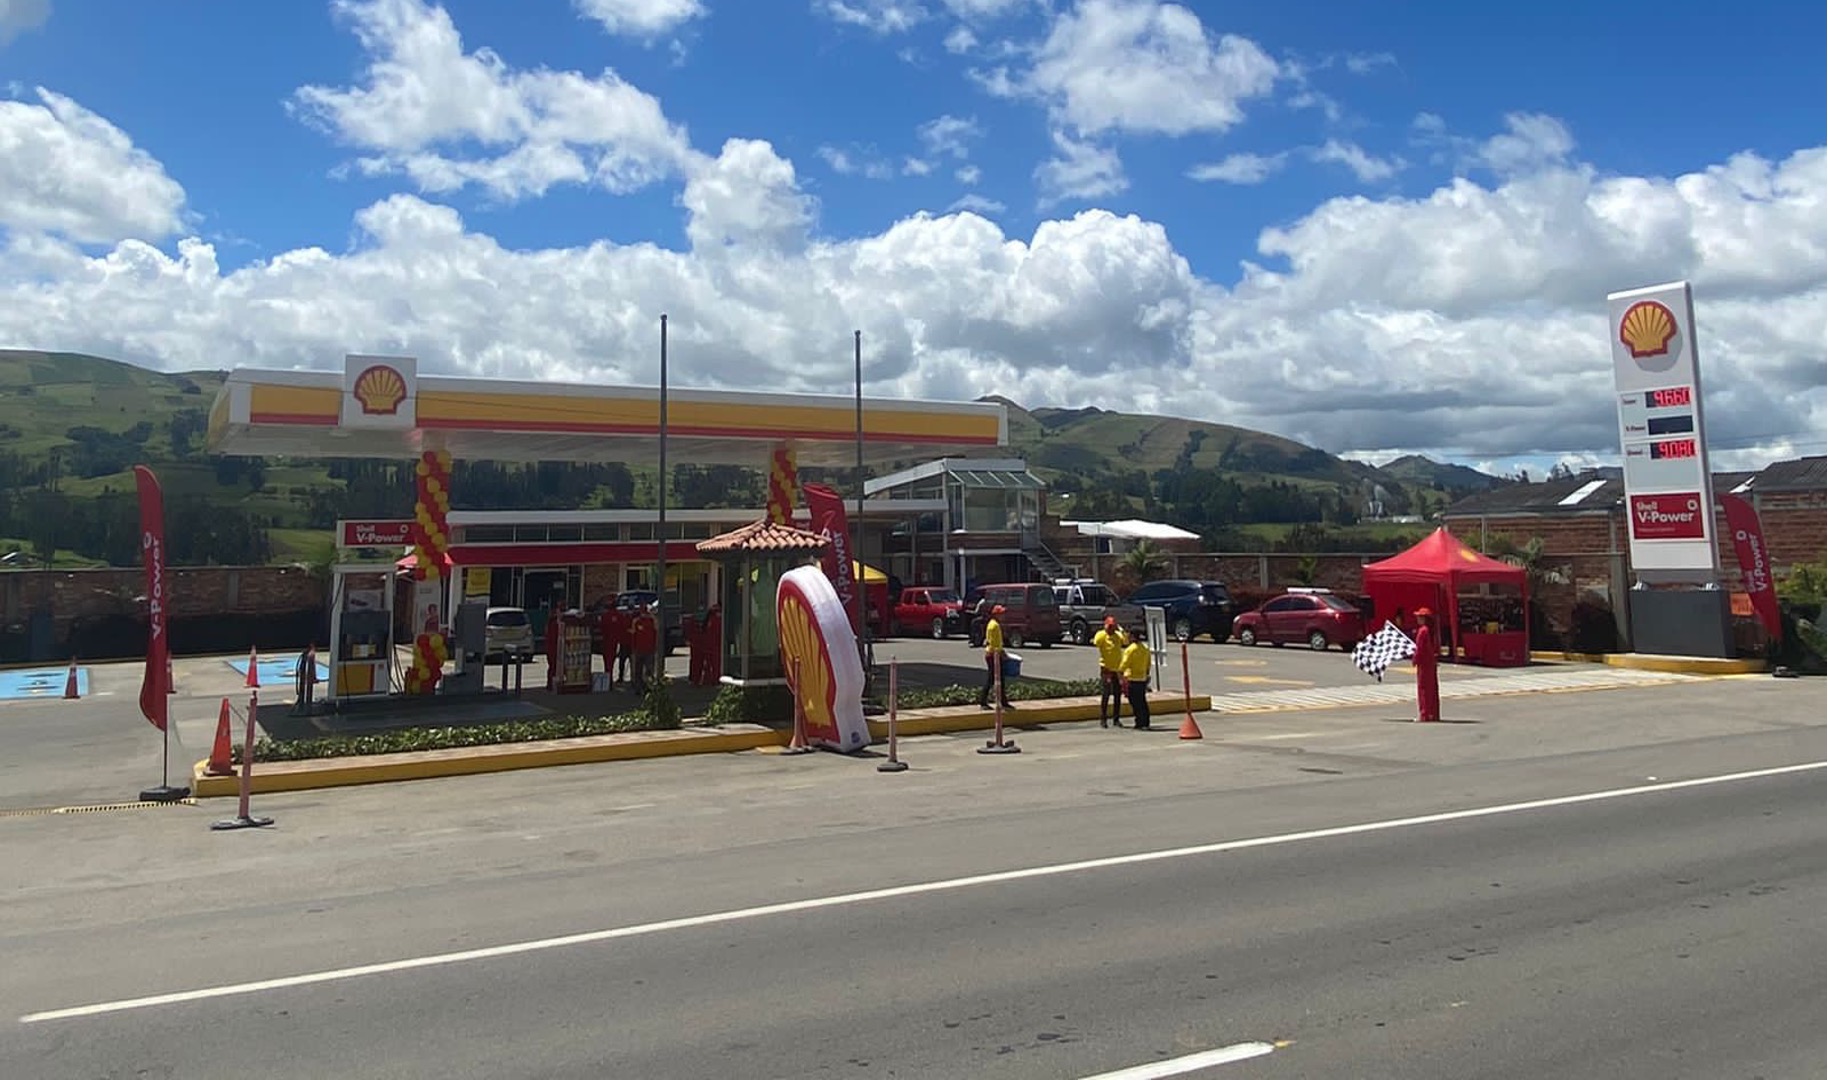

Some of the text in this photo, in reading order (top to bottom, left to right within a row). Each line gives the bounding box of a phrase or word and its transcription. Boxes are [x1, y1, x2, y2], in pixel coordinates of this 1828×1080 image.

[356, 532, 406, 543] V-Power
[1637, 510, 1694, 523] V-Power
[150, 536, 162, 640] V-Power
[834, 531, 853, 606] V-Power
[1748, 532, 1768, 591] V-Power
